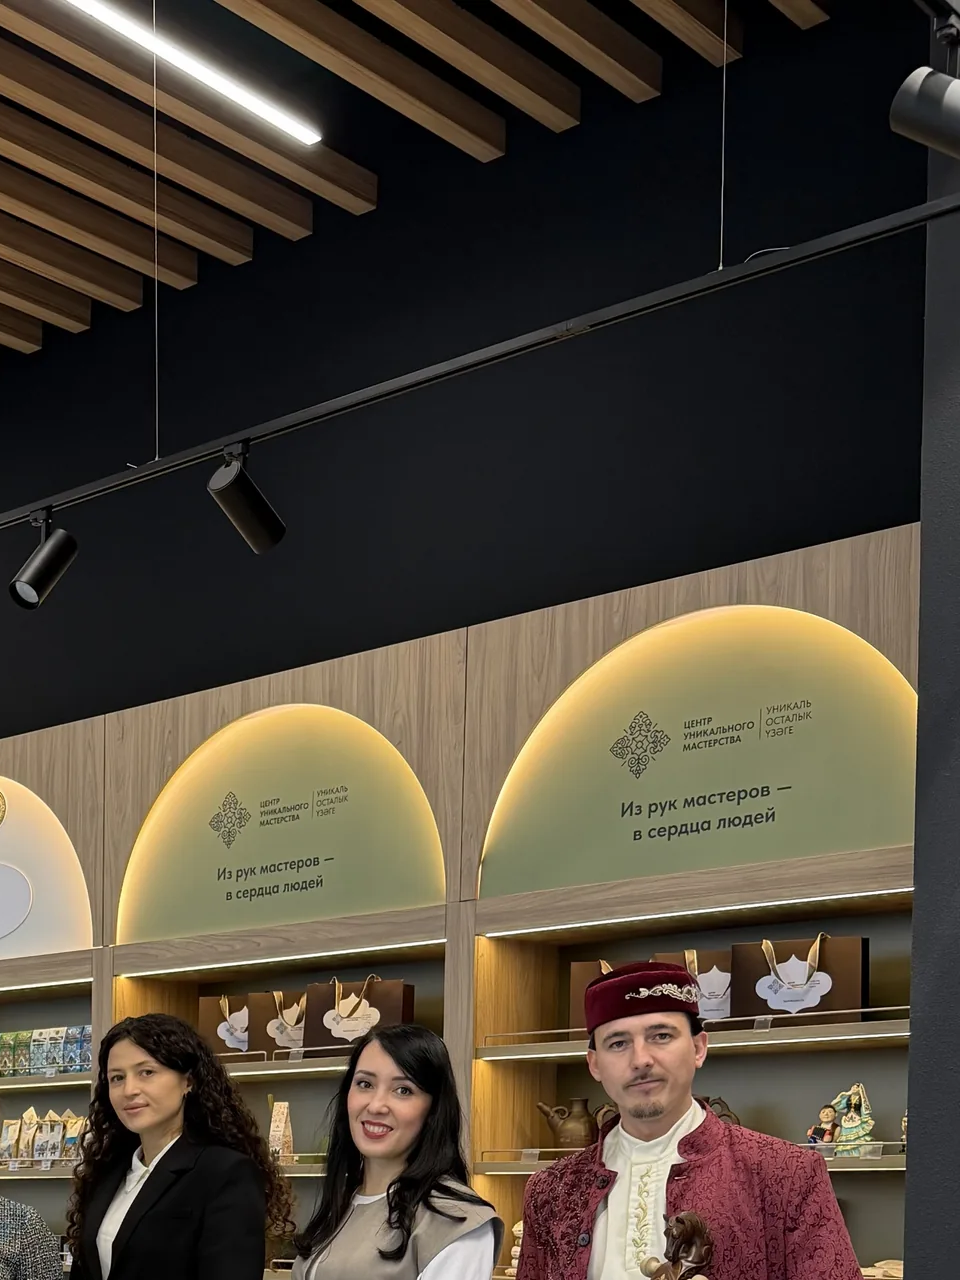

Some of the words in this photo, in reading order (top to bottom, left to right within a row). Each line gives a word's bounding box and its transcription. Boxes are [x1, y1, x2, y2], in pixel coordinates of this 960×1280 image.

[766, 699, 812, 715] УНИКАЛЬ
[684, 717, 713, 730] ЦЕНТР
[765, 711, 813, 727] ОСТАЛЫК
[683, 721, 755, 741] УНИКАЛЬНОГО
[682, 735, 742, 752] МАСТЕРСТВА
[316, 785, 349, 798] УНИКАЛЬ
[260, 798, 280, 809] ЦЕНТР
[316, 795, 349, 808] ОСТАЛЫК
[620, 801, 643, 818] Из
[647, 798, 678, 818] рук
[682, 784, 771, 809] мастеров
[260, 802, 309, 818] УНИКАЛЬНОГО
[259, 814, 300, 828] МАСТЕРСТВА
[633, 829, 642, 841] в
[647, 819, 711, 841] сердца
[716, 806, 776, 830] людей
[217, 867, 233, 882] Из
[235, 866, 257, 882] рук
[259, 856, 320, 875] мастеров
[225, 891, 232, 901] в
[235, 884, 280, 902] сердца
[282, 874, 323, 894] людей
